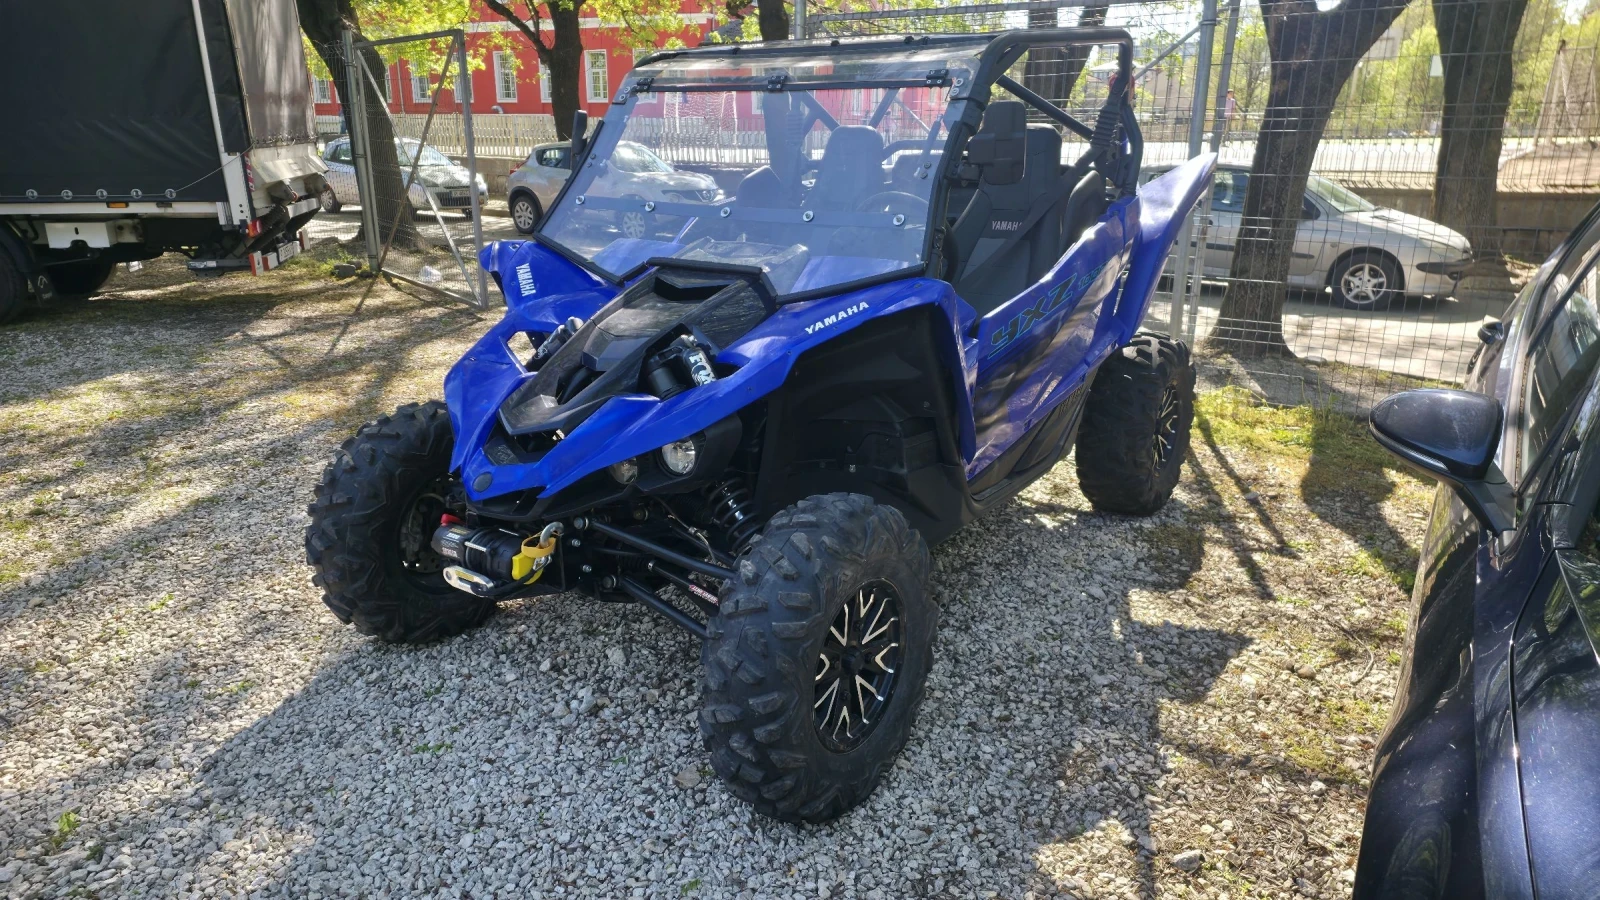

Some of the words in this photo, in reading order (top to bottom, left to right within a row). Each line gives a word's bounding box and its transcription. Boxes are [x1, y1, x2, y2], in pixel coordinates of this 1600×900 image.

[992, 220, 1022, 231] YAMAH
[516, 262, 537, 297] YAMAHA
[804, 301, 870, 335] YAMAHA
[688, 352, 717, 387] FOX
